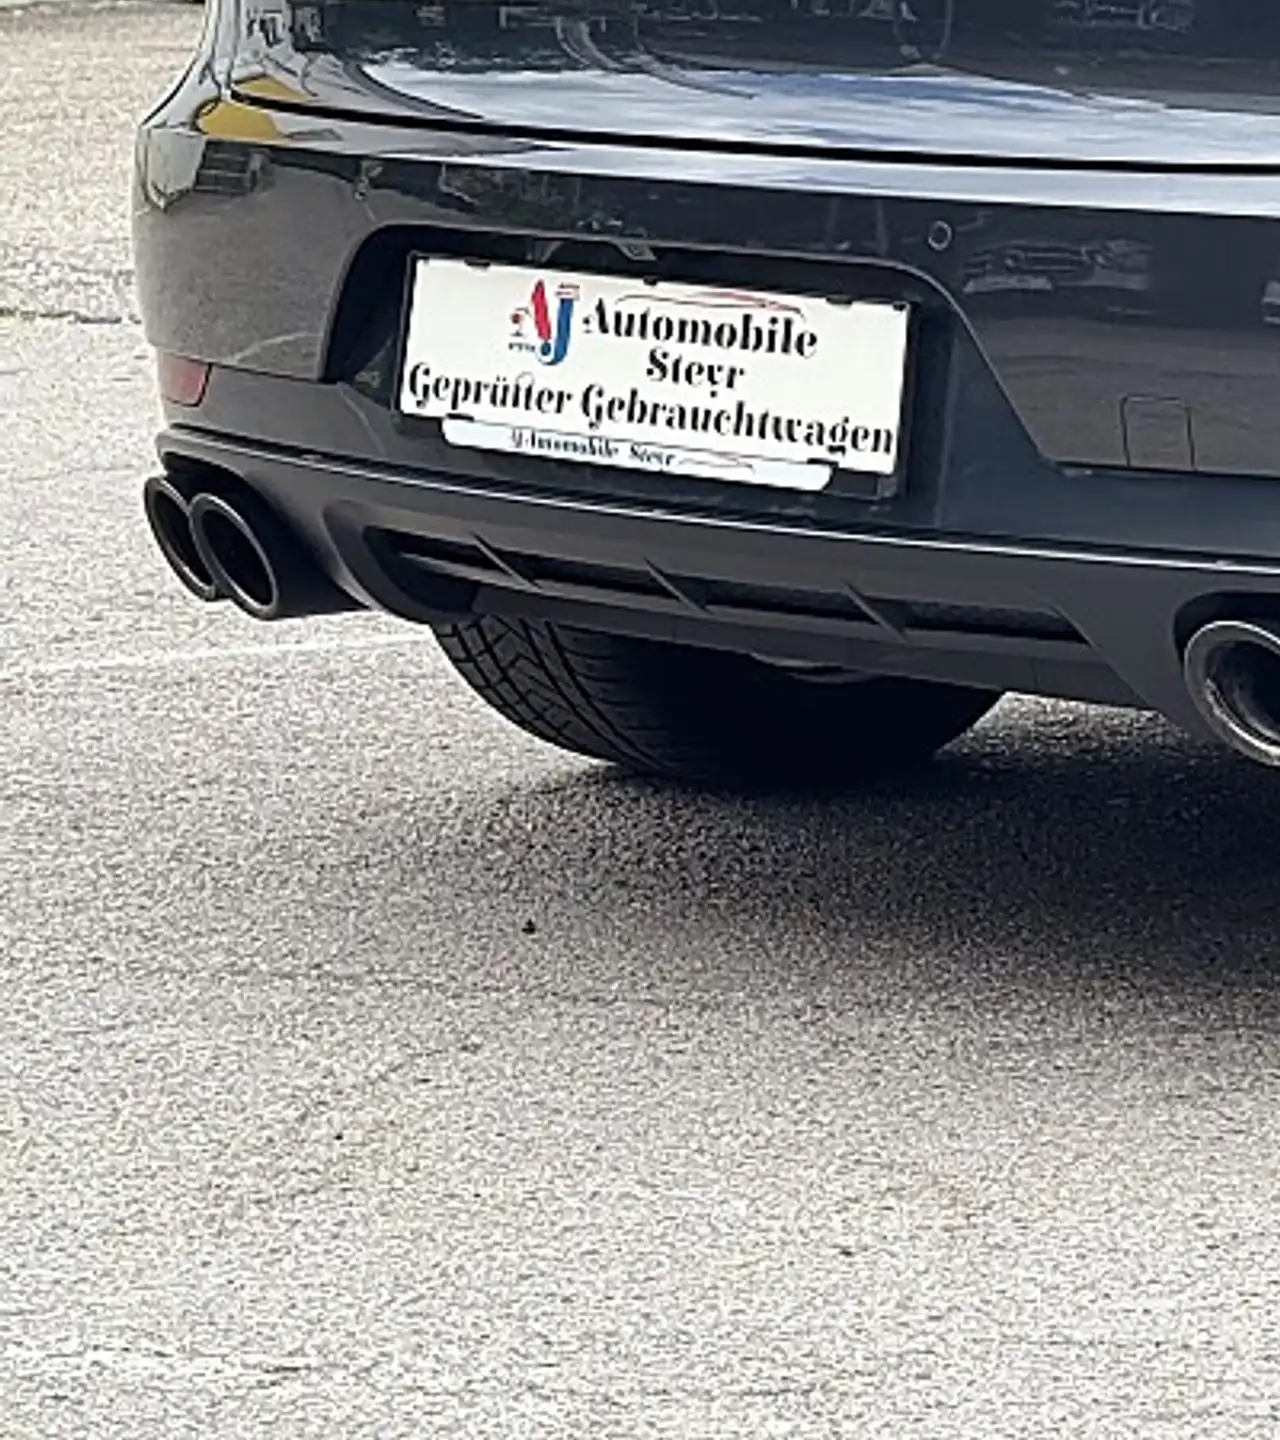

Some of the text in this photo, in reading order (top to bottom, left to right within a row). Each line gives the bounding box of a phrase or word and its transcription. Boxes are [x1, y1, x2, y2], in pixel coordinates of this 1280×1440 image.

[583, 296, 818, 360] Automobile
[646, 346, 746, 398] Steyr
[408, 360, 893, 455] Geprüfter Gebrauchtwagen
